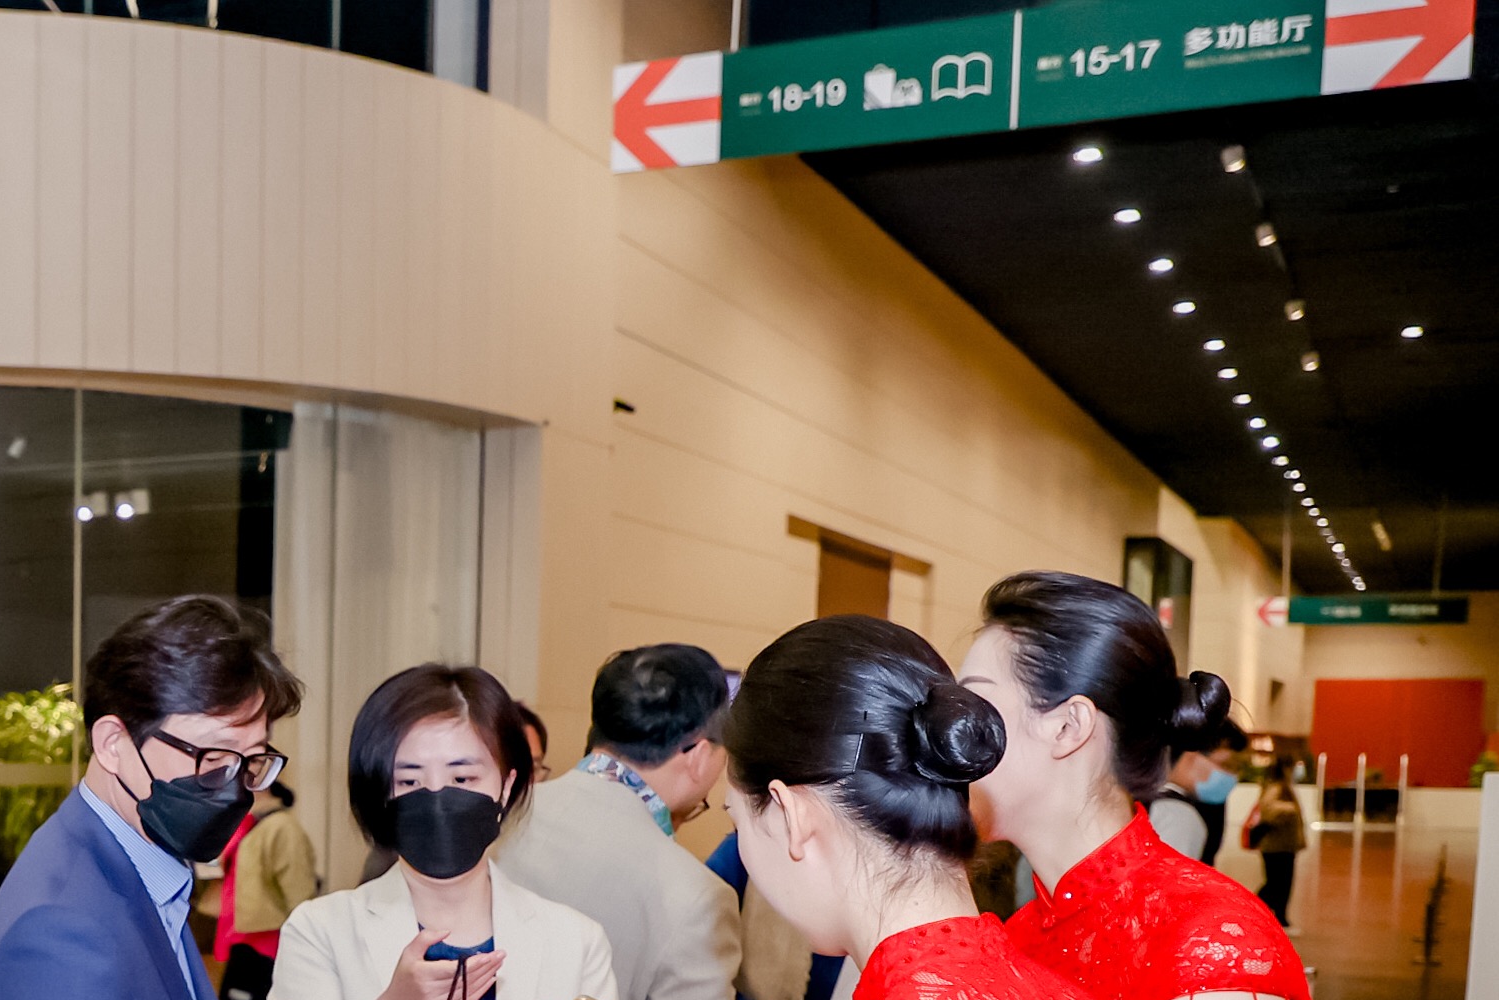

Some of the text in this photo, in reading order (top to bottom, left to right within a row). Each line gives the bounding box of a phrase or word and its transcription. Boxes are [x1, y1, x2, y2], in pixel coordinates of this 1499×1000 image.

[1070, 39, 1161, 78] 15-17
[1183, 14, 1314, 57] 多功能厅
[767, 78, 848, 113] 18-19
